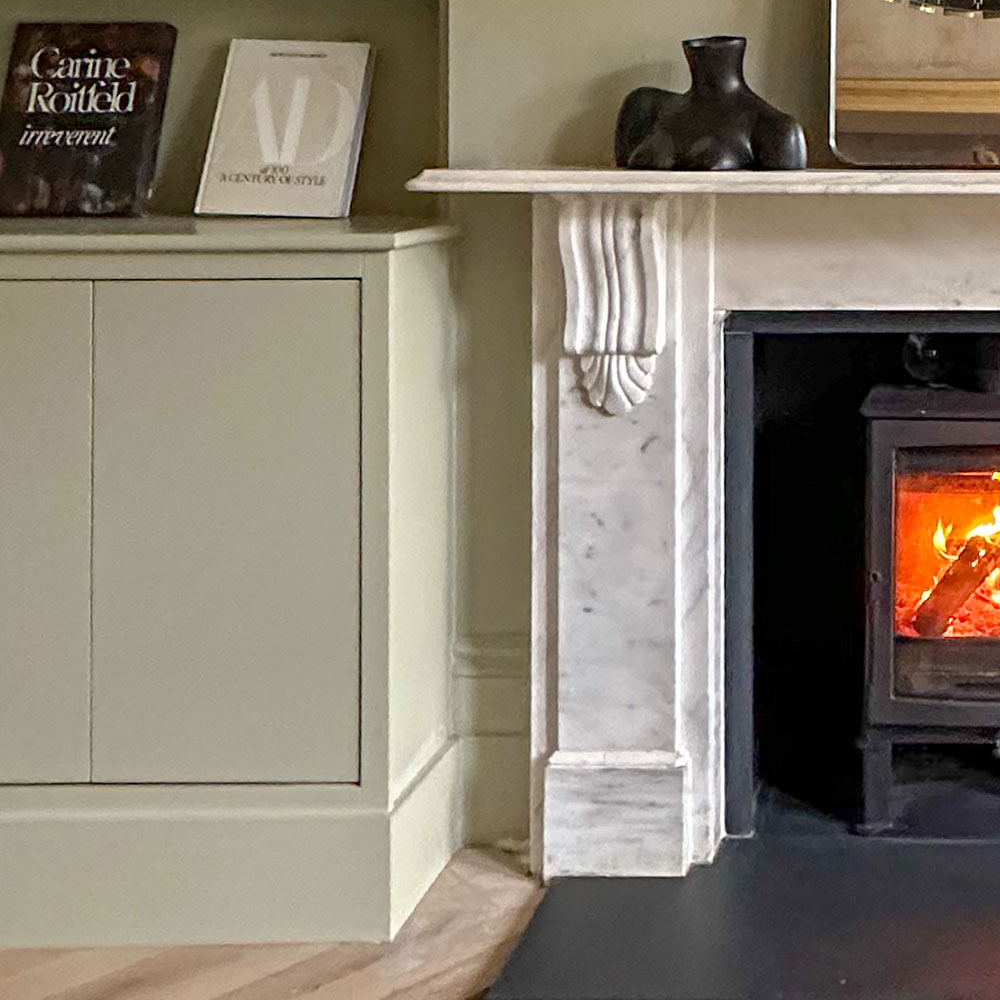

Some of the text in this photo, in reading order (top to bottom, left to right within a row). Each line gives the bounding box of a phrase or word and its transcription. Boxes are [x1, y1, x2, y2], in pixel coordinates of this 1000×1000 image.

[31, 47, 131, 79] Carine
[26, 80, 136, 113] Roitfeld
[19, 124, 116, 146] irreverent
